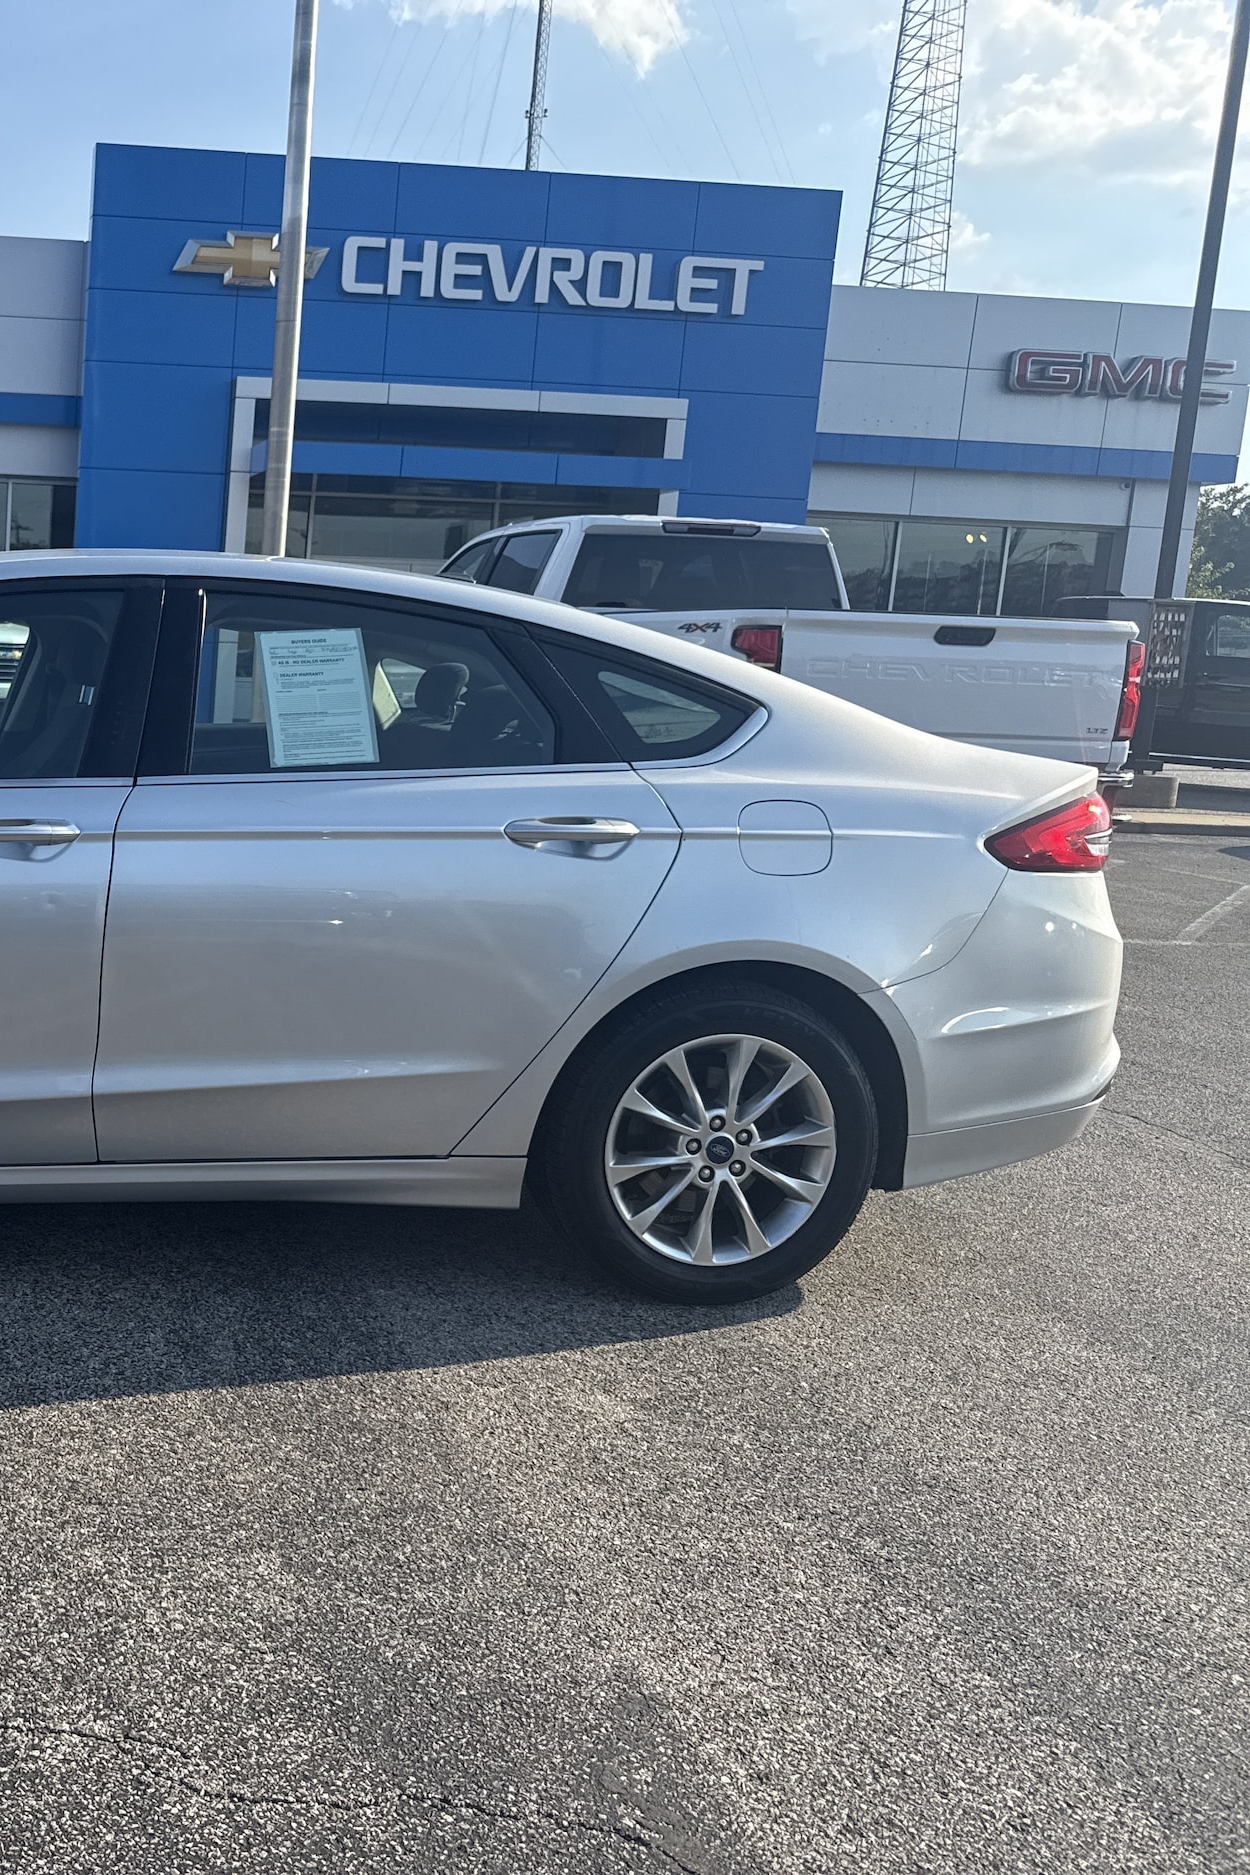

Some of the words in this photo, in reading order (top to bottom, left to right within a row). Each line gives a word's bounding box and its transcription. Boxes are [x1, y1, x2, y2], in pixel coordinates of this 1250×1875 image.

[340, 235, 764, 316] CHEVROLET
[1008, 348, 1237, 404] GMC
[806, 657, 1106, 688] CHEVROLET
